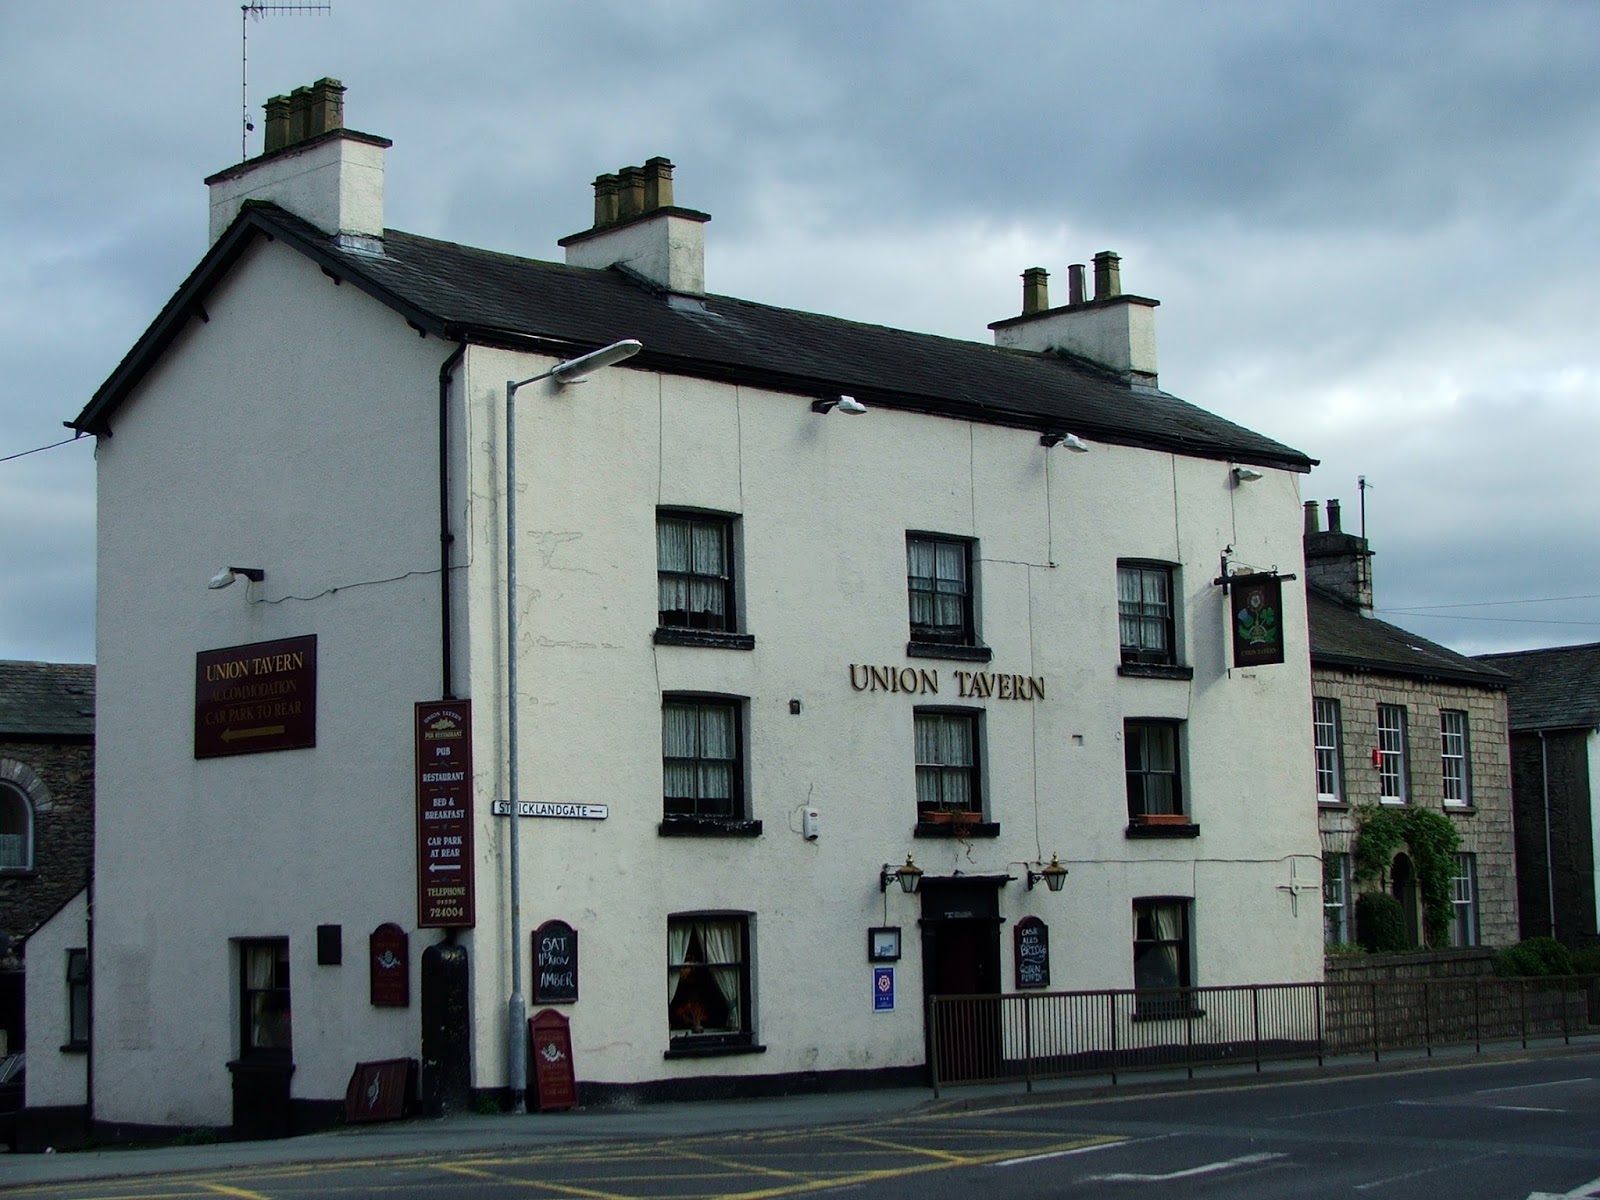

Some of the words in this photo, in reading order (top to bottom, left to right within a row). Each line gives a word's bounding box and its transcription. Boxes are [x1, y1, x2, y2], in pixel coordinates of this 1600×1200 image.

[206, 660, 249, 681] UNION
[252, 652, 304, 675] TAVERN
[849, 663, 939, 694] UNION
[954, 669, 1046, 701] TAVERN
[212, 679, 296, 702] ACCOMMODATION
[205, 711, 226, 725] CAR
[228, 705, 254, 721] PARK
[256, 704, 272, 719] TO
[274, 700, 303, 717] REAR
[436, 747, 451, 756] PUB
[423, 772, 464, 782] RESTAURANT
[433, 798, 447, 807] BED
[448, 797, 455, 806] &
[425, 809, 465, 820] BREAKFAST
[500, 802, 587, 816] STICKLANDGATE
[427, 836, 442, 846] CAR
[443, 836, 463, 846] PARK
[430, 849, 440, 858] AT
[441, 848, 460, 857] REAR
[427, 886, 466, 897] TELEPHONE
[430, 907, 464, 917] 724004
[542, 937, 567, 952] SAT
[548, 956, 569, 965] NOV
[540, 972, 574, 988] AMBER
